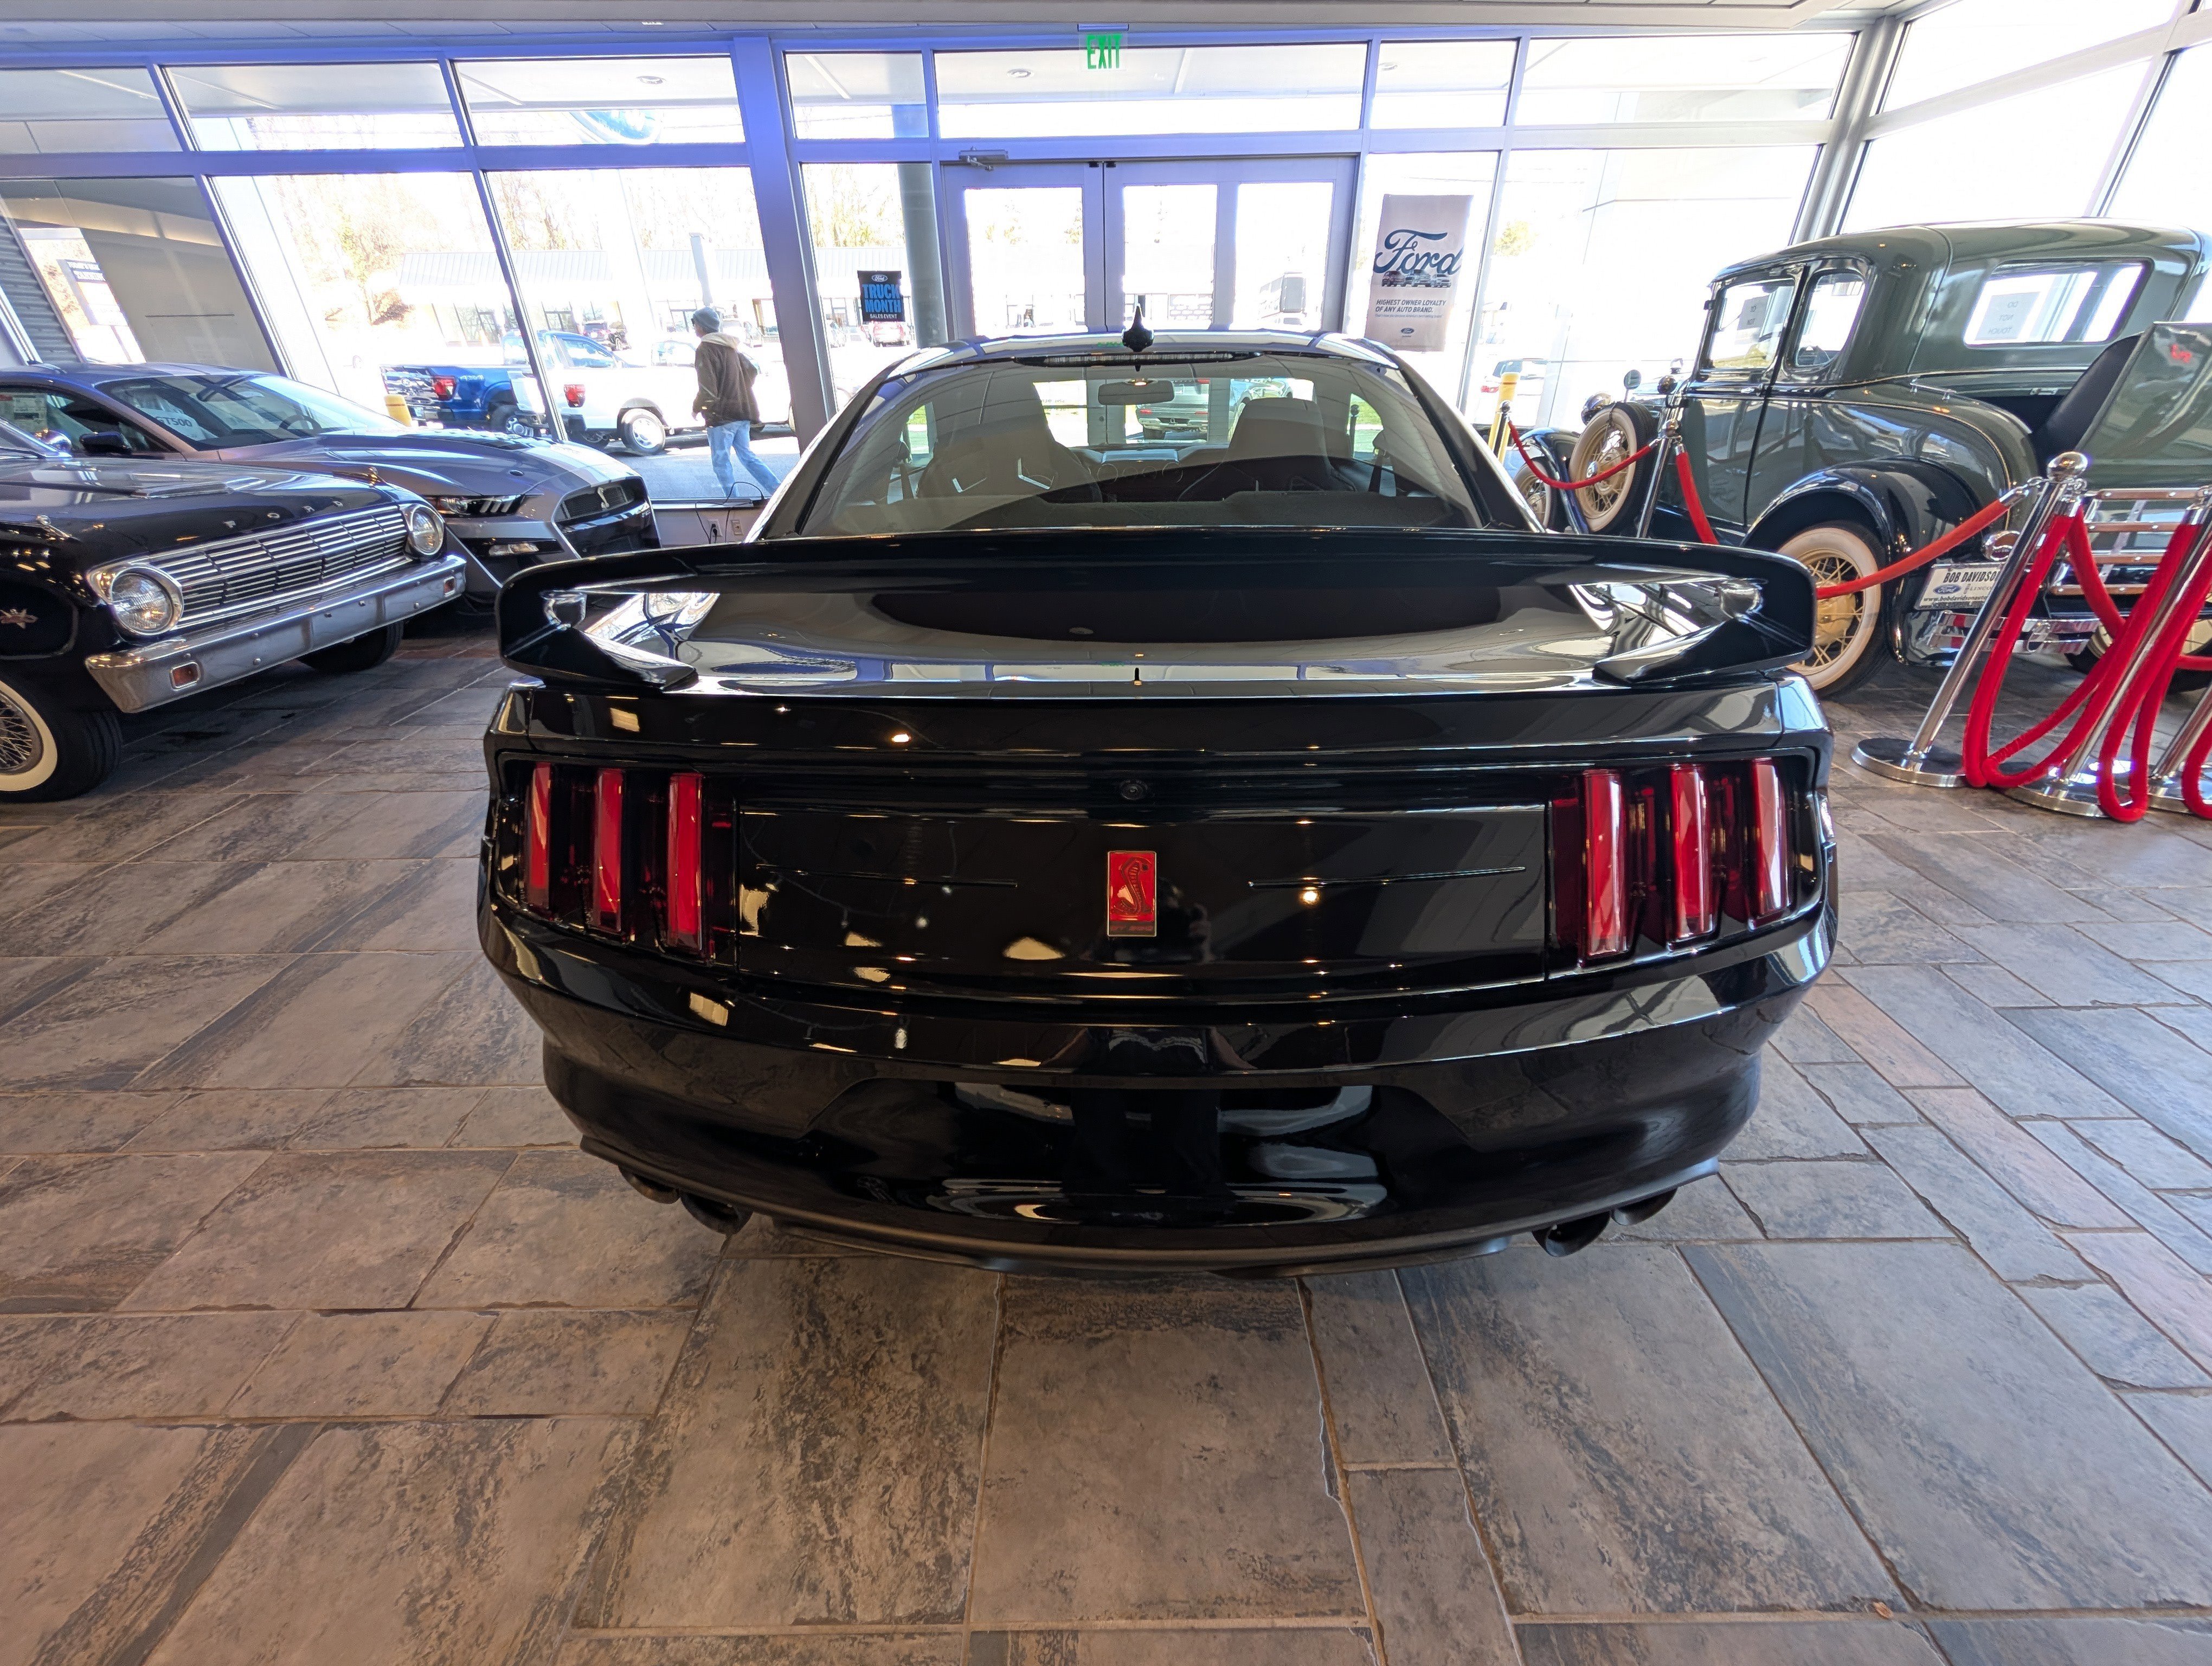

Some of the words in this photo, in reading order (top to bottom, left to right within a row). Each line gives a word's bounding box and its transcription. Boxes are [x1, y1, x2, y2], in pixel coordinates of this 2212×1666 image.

[1086, 34, 1122, 69] EXIT
[1373, 229, 1464, 275] Ford
[862, 284, 900, 299] TRUCK
[864, 299, 902, 313] MONTH
[155, 416, 192, 426] GT500
[1943, 572, 1961, 583] BOB
